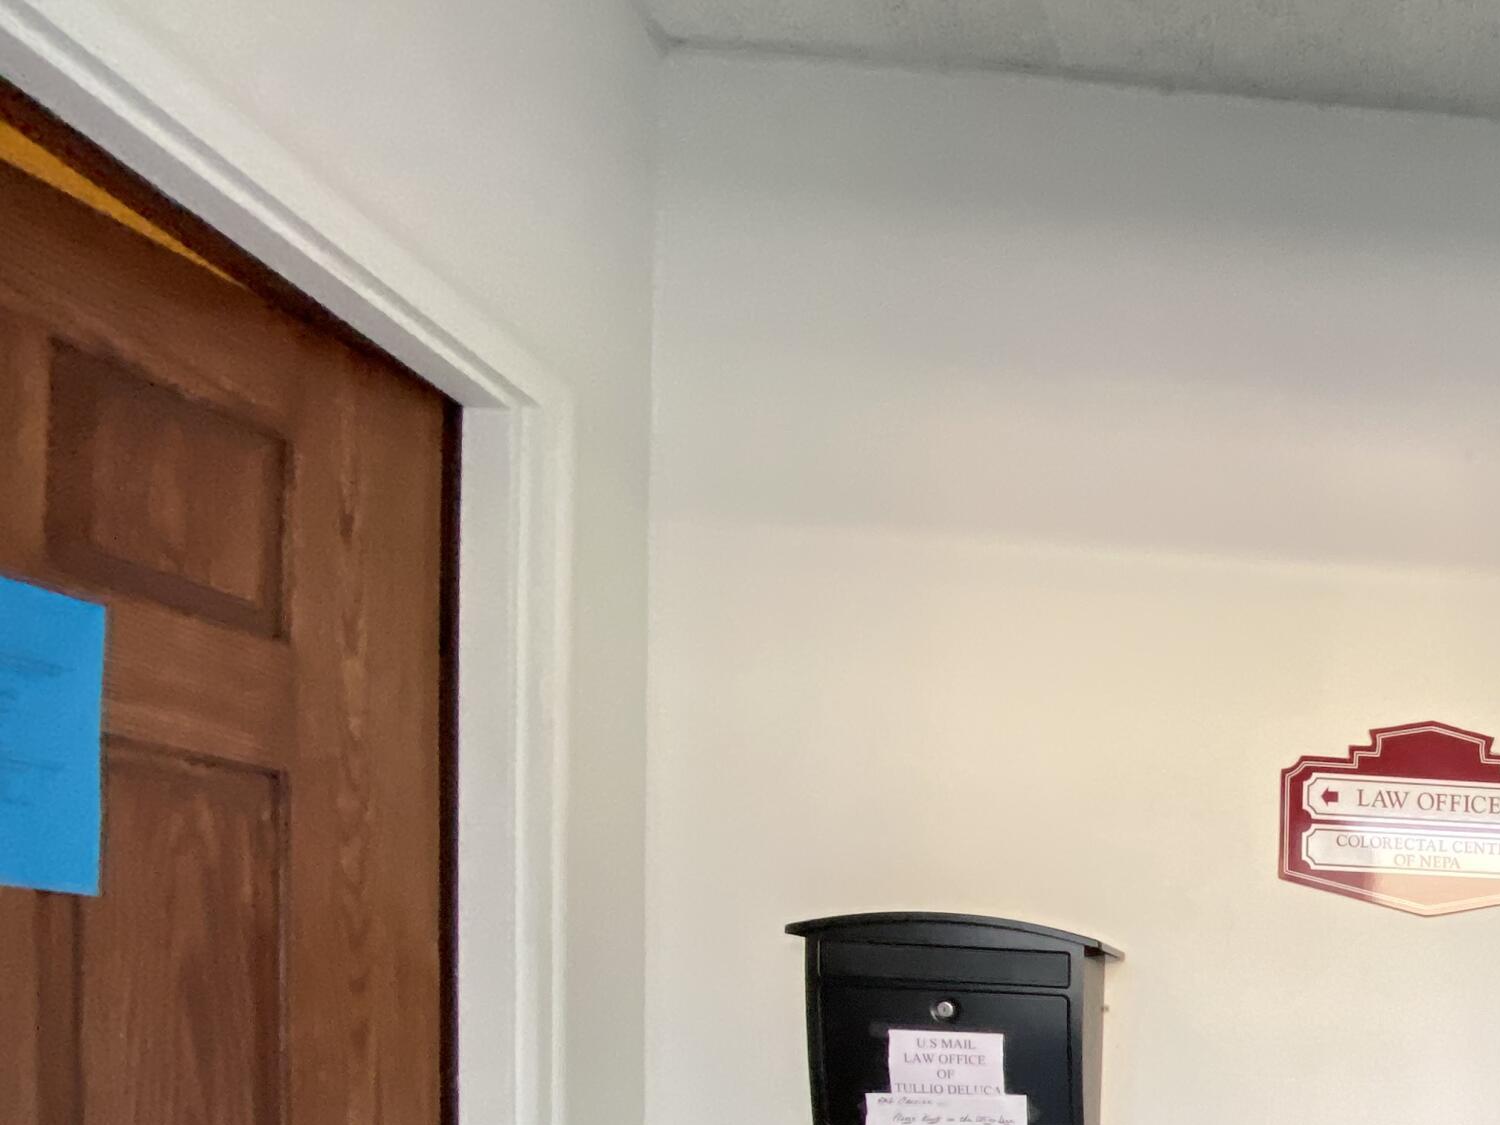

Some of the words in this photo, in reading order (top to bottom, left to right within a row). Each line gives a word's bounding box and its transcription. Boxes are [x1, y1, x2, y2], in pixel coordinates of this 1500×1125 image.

[1357, 788, 1410, 809] LAW
[1336, 834, 1448, 853] COLORECTAL
[1393, 854, 1415, 867] OF
[1419, 855, 1461, 869] NEPA
[941, 1038, 976, 1049] MAIL
[904, 1053, 934, 1063] LAW
[938, 1054, 986, 1065] OFFICE
[936, 1069, 955, 1079] OF
[895, 1083, 944, 1094] TULLIO
